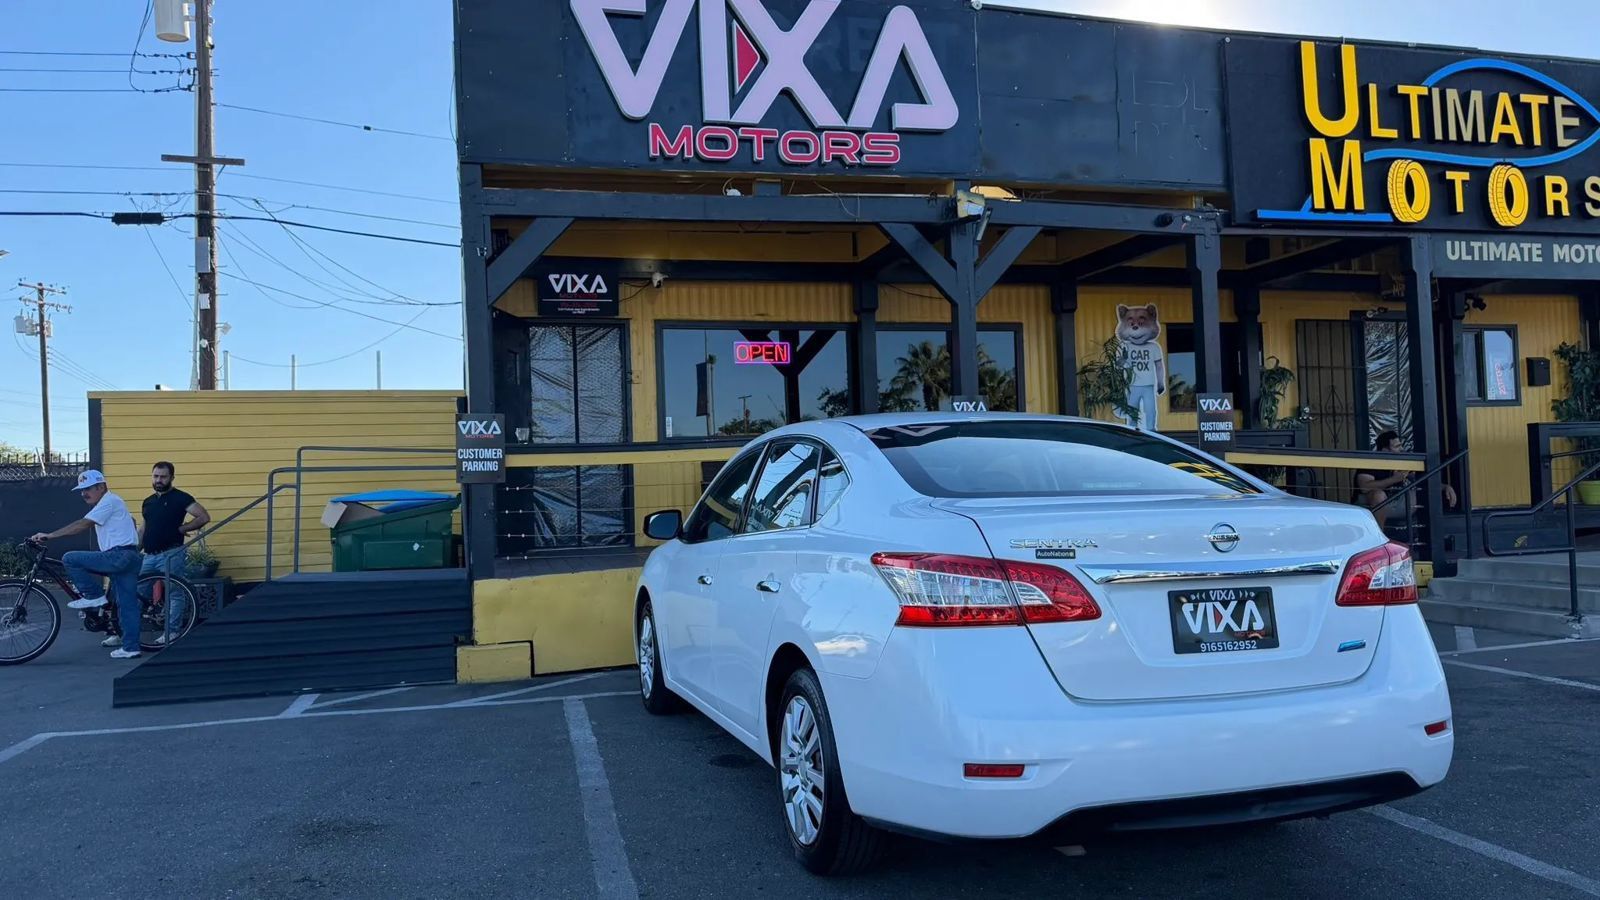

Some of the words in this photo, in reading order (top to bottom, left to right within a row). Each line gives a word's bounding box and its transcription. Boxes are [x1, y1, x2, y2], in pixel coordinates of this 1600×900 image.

[569, 0, 960, 130] VIXA
[1300, 40, 1582, 149] ULTIMATE
[648, 122, 902, 165] MOTORS
[1309, 138, 1600, 227] MOTORS
[1446, 240, 1543, 263] ULTIMATE
[548, 273, 608, 294] VIXA
[736, 343, 788, 362] OPEN
[1130, 349, 1151, 361] CAR
[1131, 360, 1151, 371] FOX
[952, 400, 988, 412] VIXA
[1199, 398, 1233, 411] VIXA
[457, 420, 502, 435] VIXA
[1200, 421, 1234, 432] CUSTOMER
[1204, 431, 1232, 442] PARKING
[457, 448, 503, 460] CUSTOMER
[462, 460, 500, 472] PARKING
[1009, 537, 1099, 549] SENTRA
[1212, 534, 1239, 542] NISSAN
[1036, 550, 1070, 558] AutoNation
[1209, 589, 1236, 601] VIXA
[1181, 599, 1265, 634] VIXA
[1200, 640, 1258, 653] 9165162952
